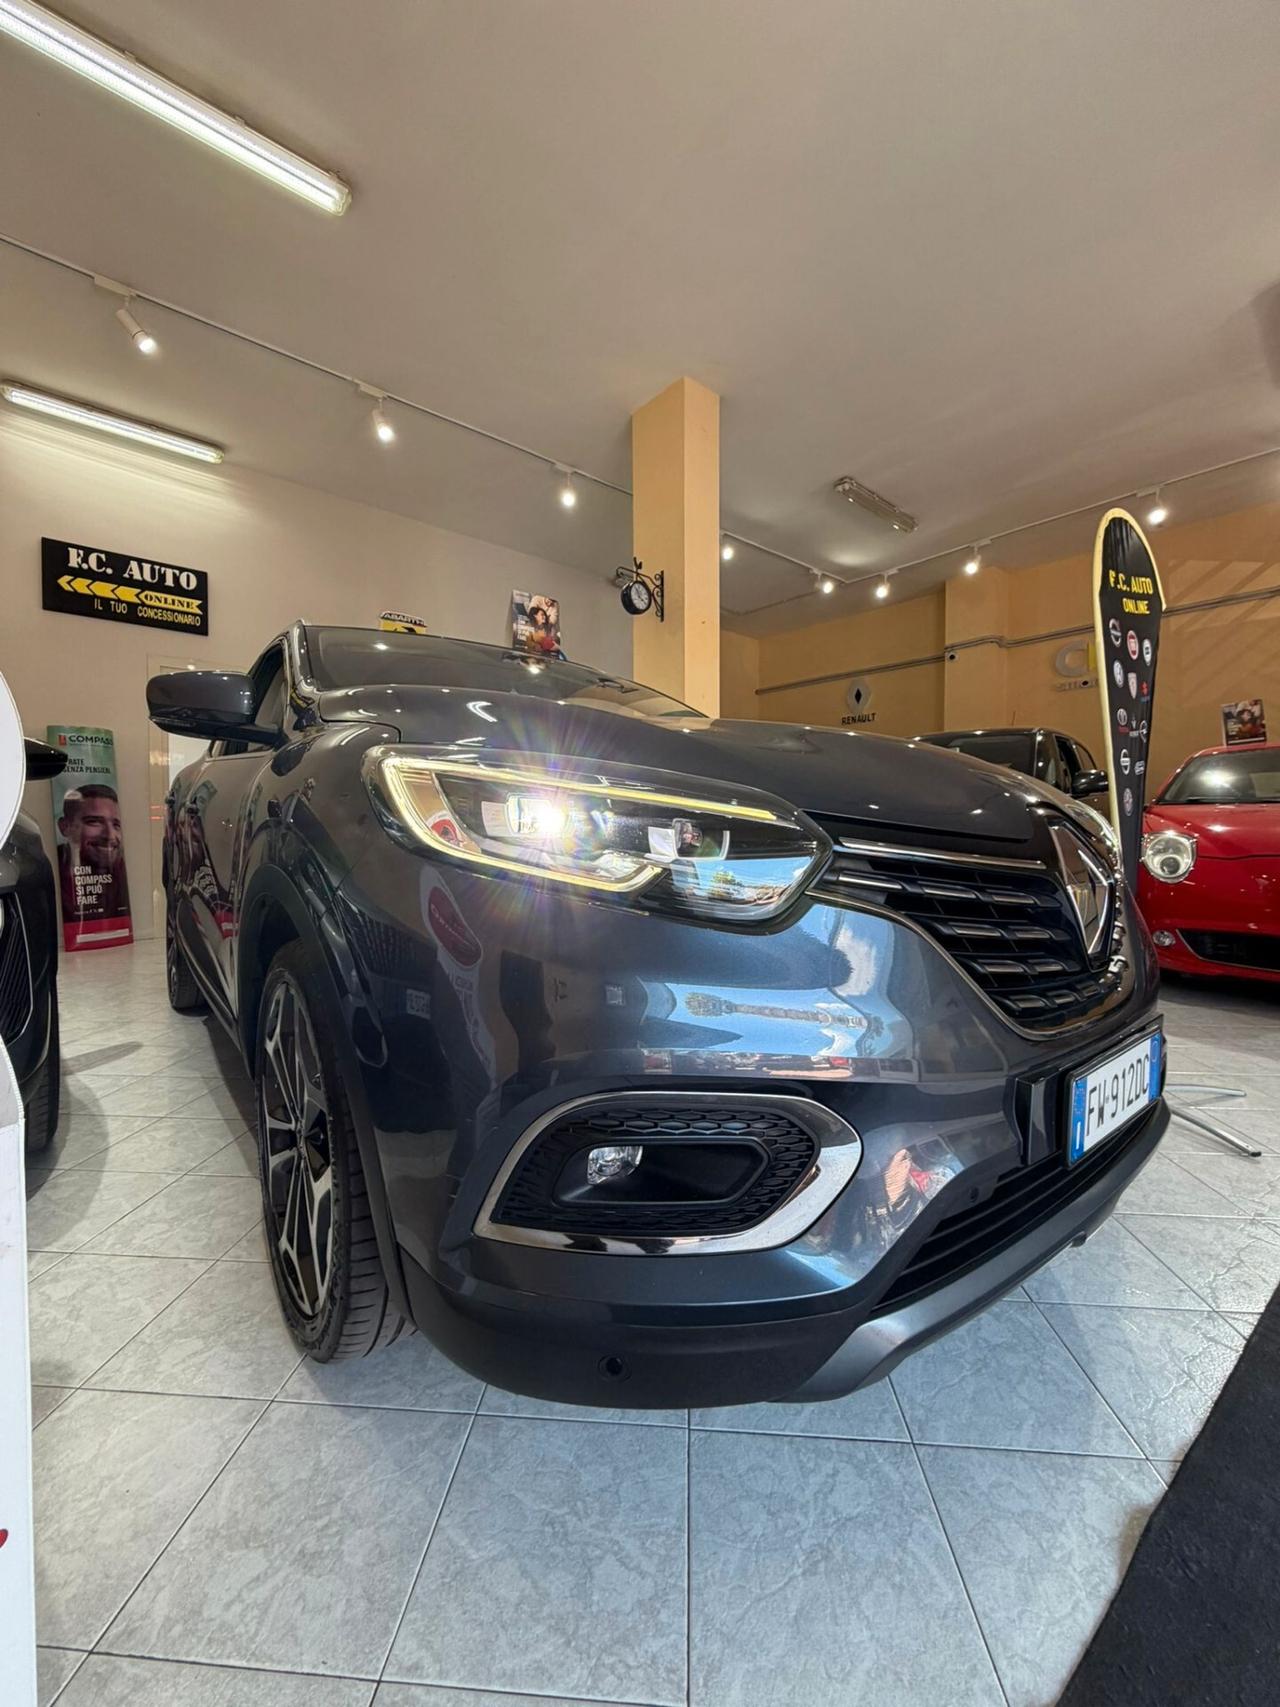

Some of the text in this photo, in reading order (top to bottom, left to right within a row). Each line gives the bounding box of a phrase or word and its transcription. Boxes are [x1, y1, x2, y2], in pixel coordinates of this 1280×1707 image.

[67, 547, 198, 591] F.C. AUTO
[1131, 575, 1154, 595] AUTO
[144, 593, 196, 610] ONLINE
[1122, 597, 1151, 615] ONLINE
[94, 598, 201, 626] IL TUO CONCESSIONARIO
[382, 612, 425, 626] ABARTH
[841, 713, 876, 725] RENAULT
[74, 866, 92, 876] CON
[75, 874, 113, 886] COMPASS
[76, 886, 85, 896] SI
[77, 895, 99, 906] FARE
